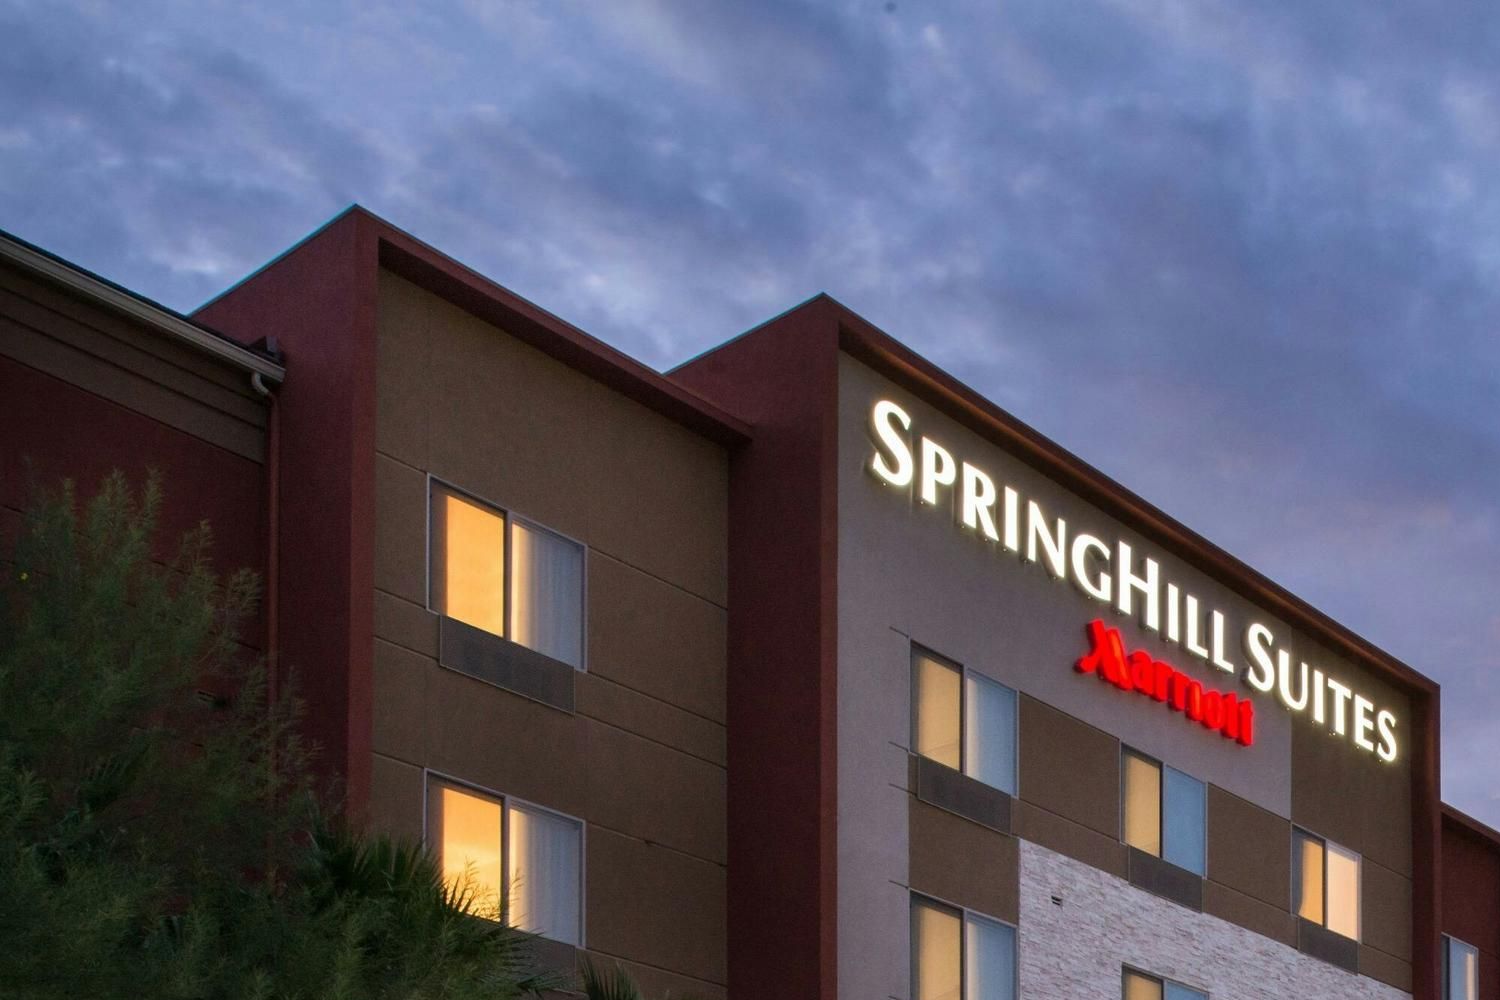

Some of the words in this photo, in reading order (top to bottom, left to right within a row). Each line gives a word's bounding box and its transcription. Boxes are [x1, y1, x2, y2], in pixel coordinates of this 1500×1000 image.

[870, 400, 1234, 673] SPRINGHILL
[1247, 624, 1397, 762] SUITES
[1076, 619, 1254, 746] Marriott
